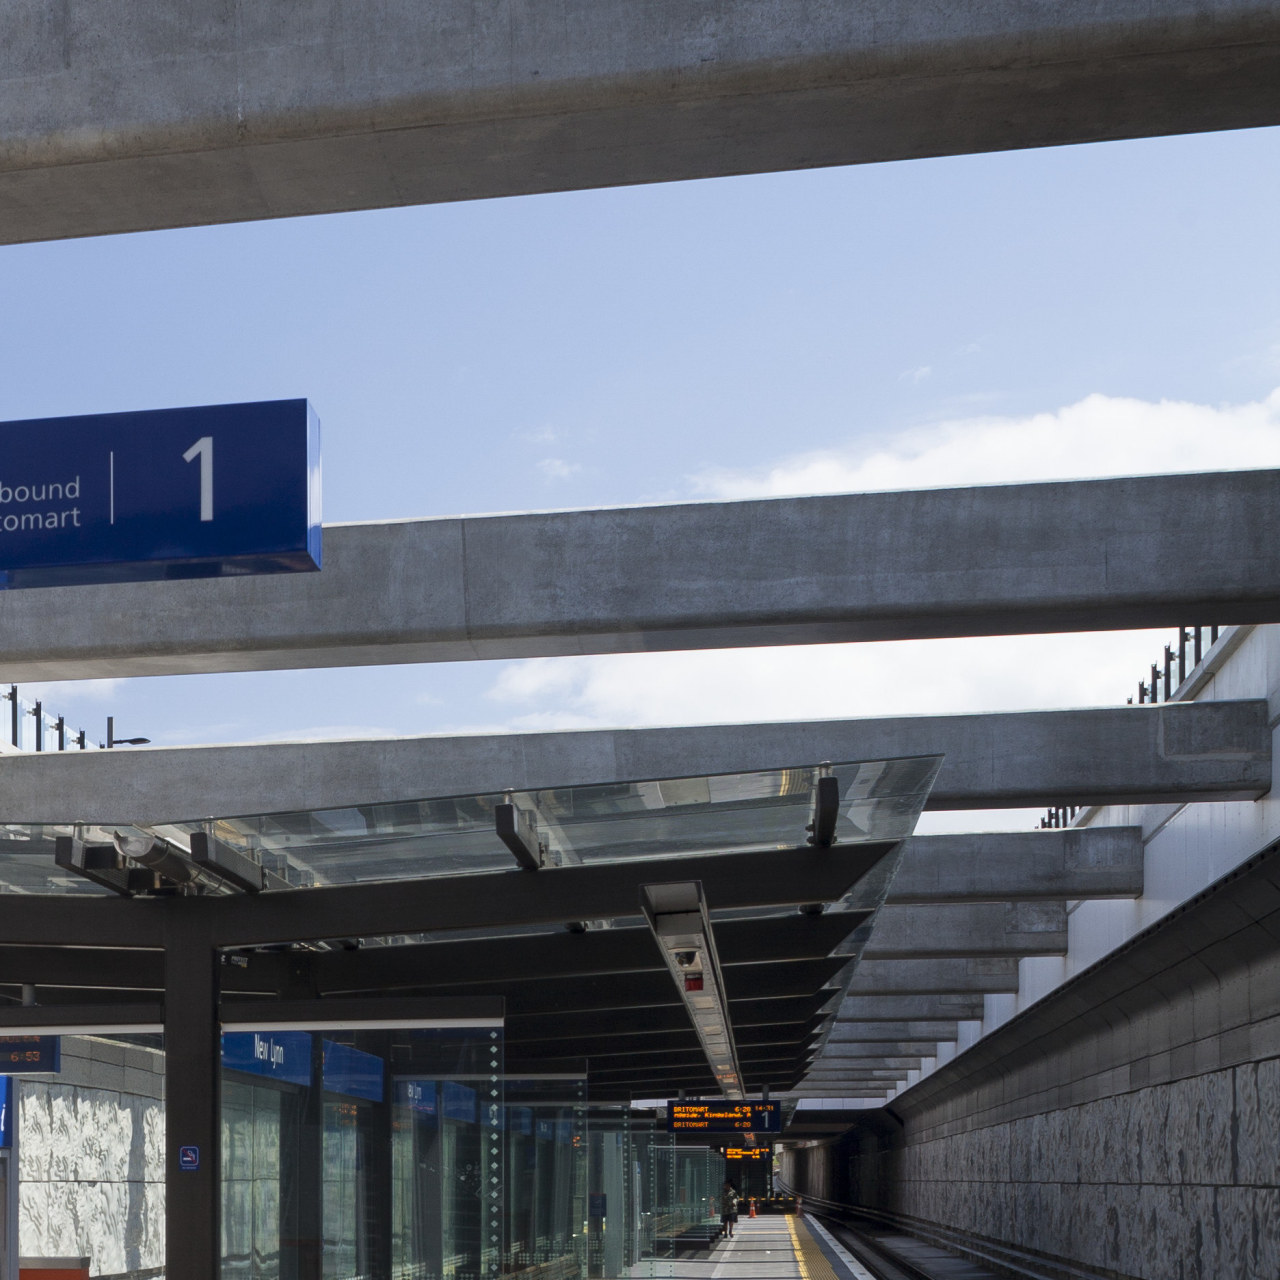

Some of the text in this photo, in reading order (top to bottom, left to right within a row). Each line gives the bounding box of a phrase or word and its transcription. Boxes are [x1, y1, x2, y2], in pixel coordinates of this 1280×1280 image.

[182, 436, 213, 522] 1
[10, 1051, 41, 1063] 6:53
[254, 1033, 284, 1069] New Lynn
[761, 1111, 769, 1129] 1
